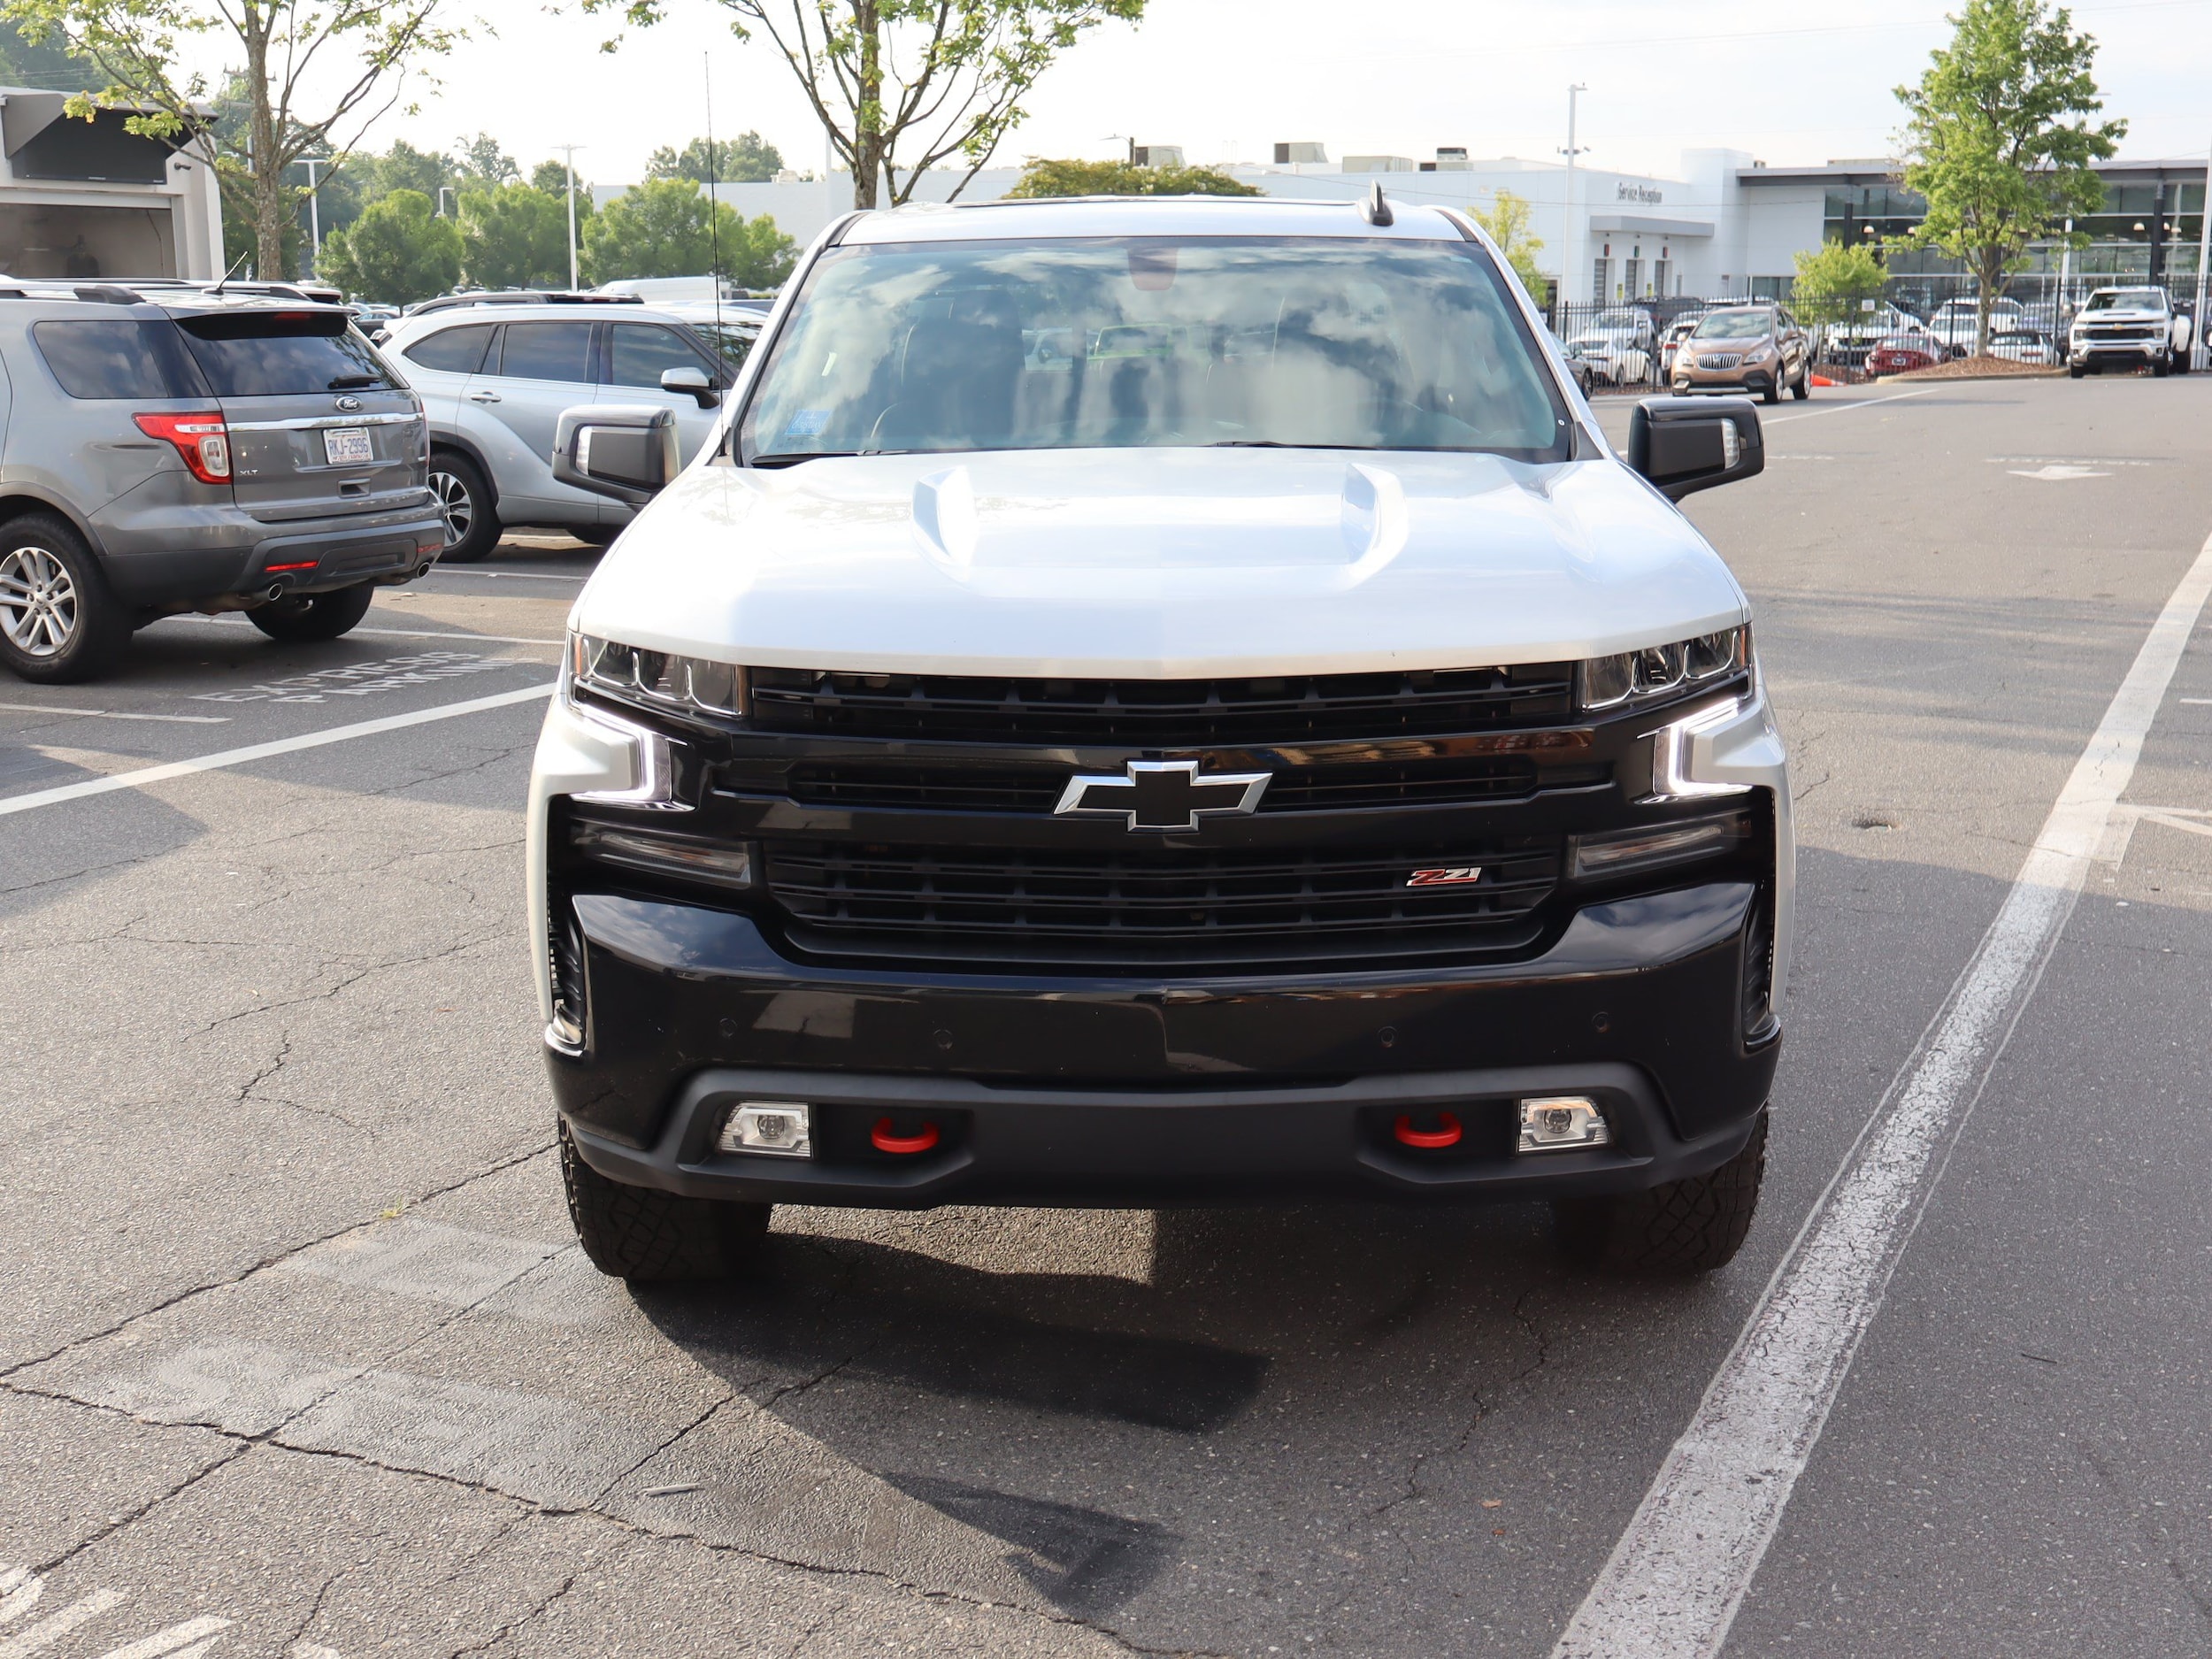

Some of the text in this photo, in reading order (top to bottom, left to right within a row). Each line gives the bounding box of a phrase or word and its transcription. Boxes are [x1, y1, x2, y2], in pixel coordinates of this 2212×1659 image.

[1618, 182, 1637, 201] Service
[188, 651, 480, 702] EXPRESS
[268, 658, 542, 703] PARKING
